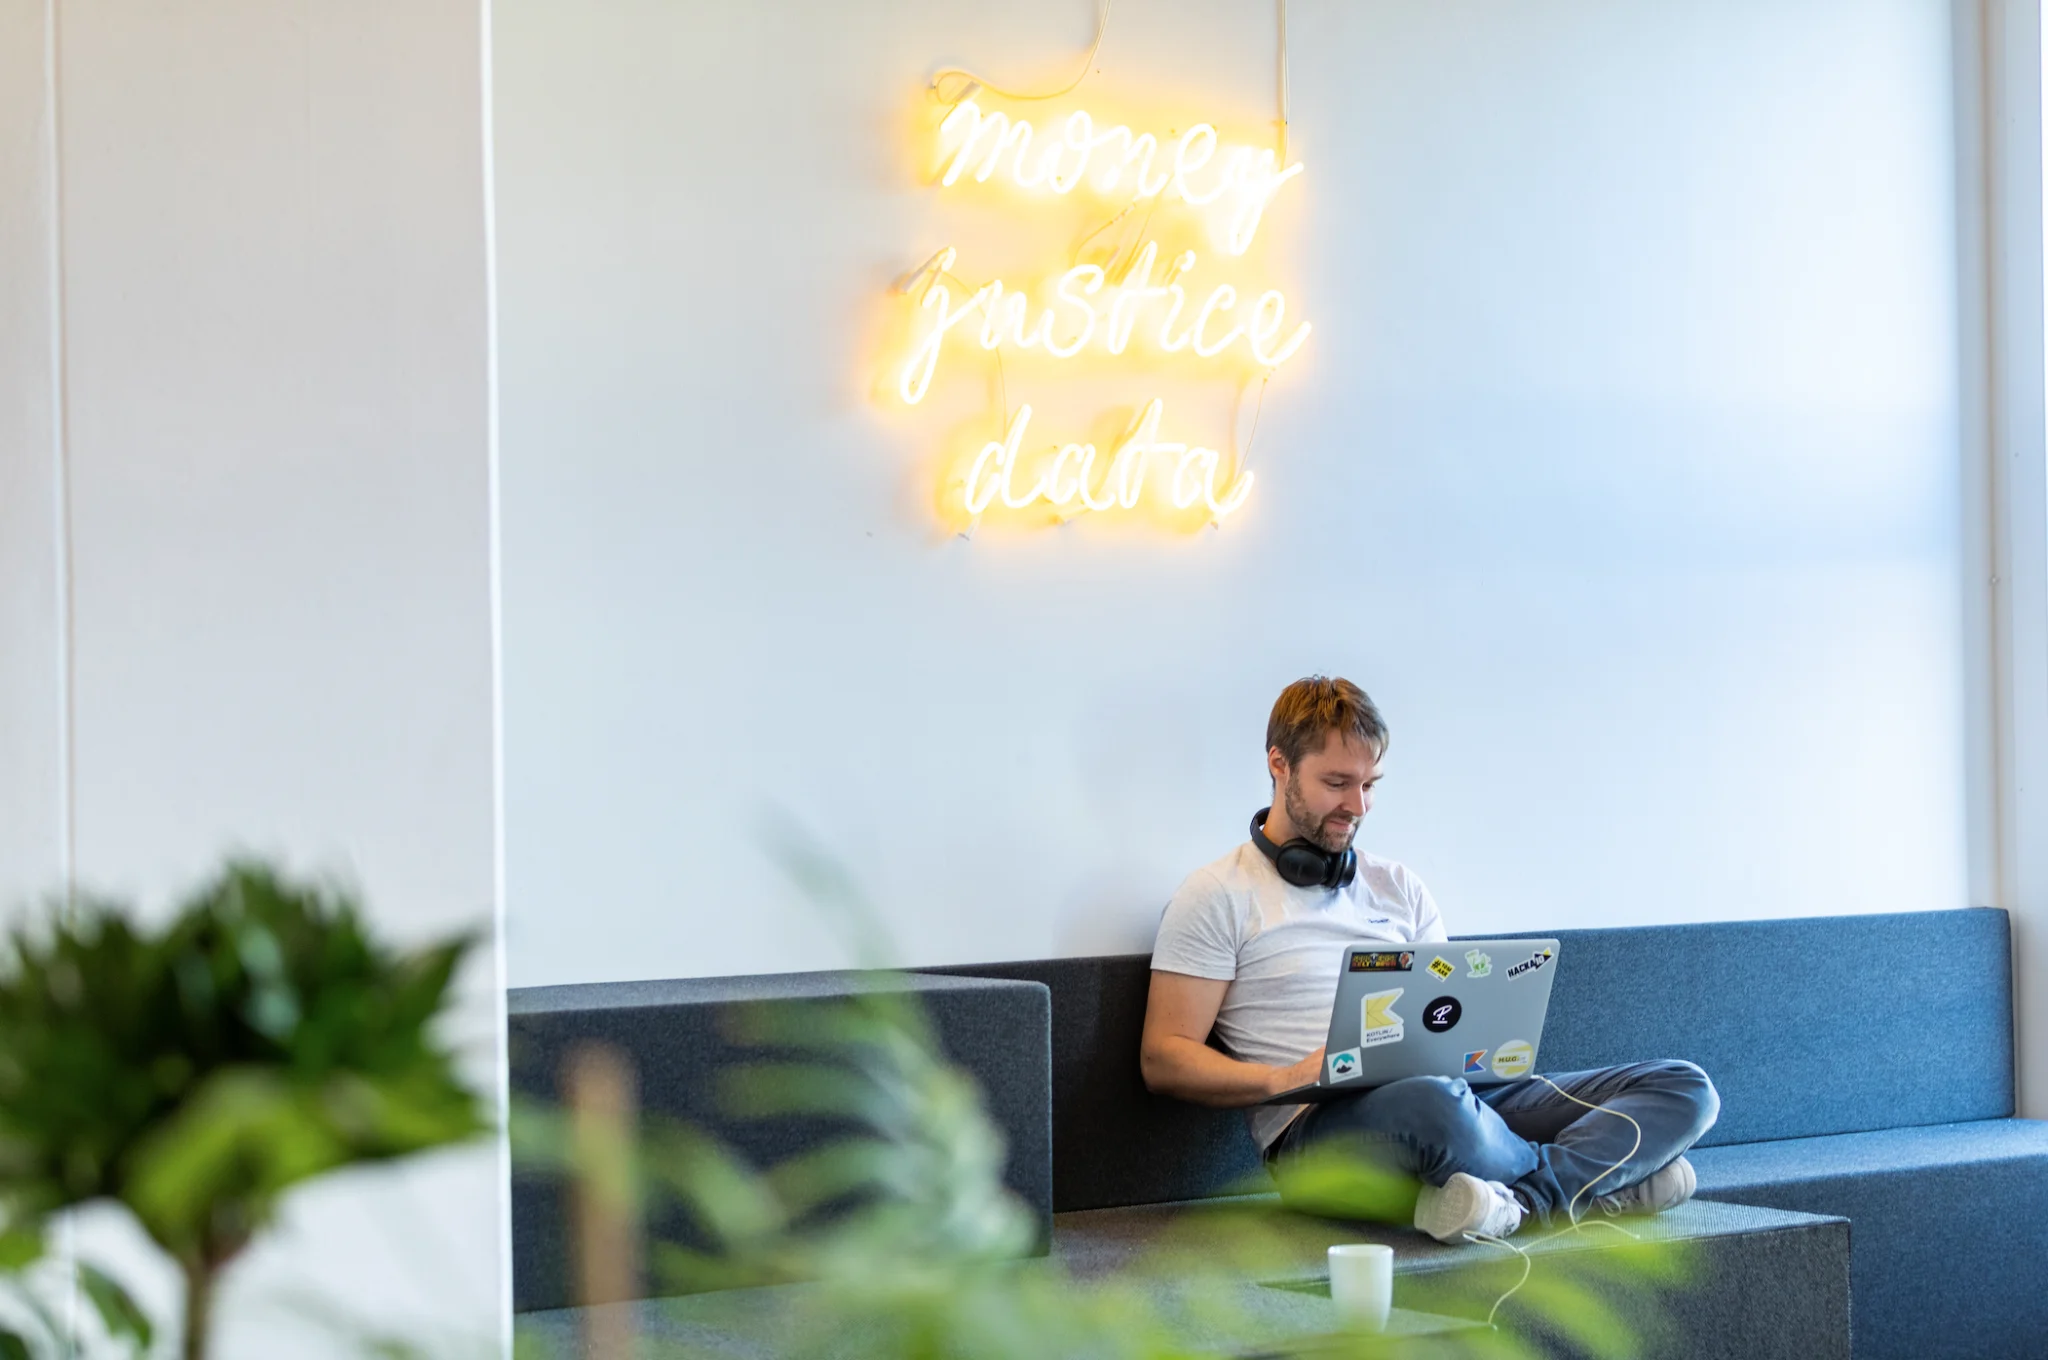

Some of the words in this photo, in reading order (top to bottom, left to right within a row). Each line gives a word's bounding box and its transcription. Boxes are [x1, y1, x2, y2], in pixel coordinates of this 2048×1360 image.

[939, 101, 1305, 256] money
[899, 240, 1313, 404] justice
[964, 398, 1255, 515] data
[1366, 1033, 1400, 1043] Everywhere
